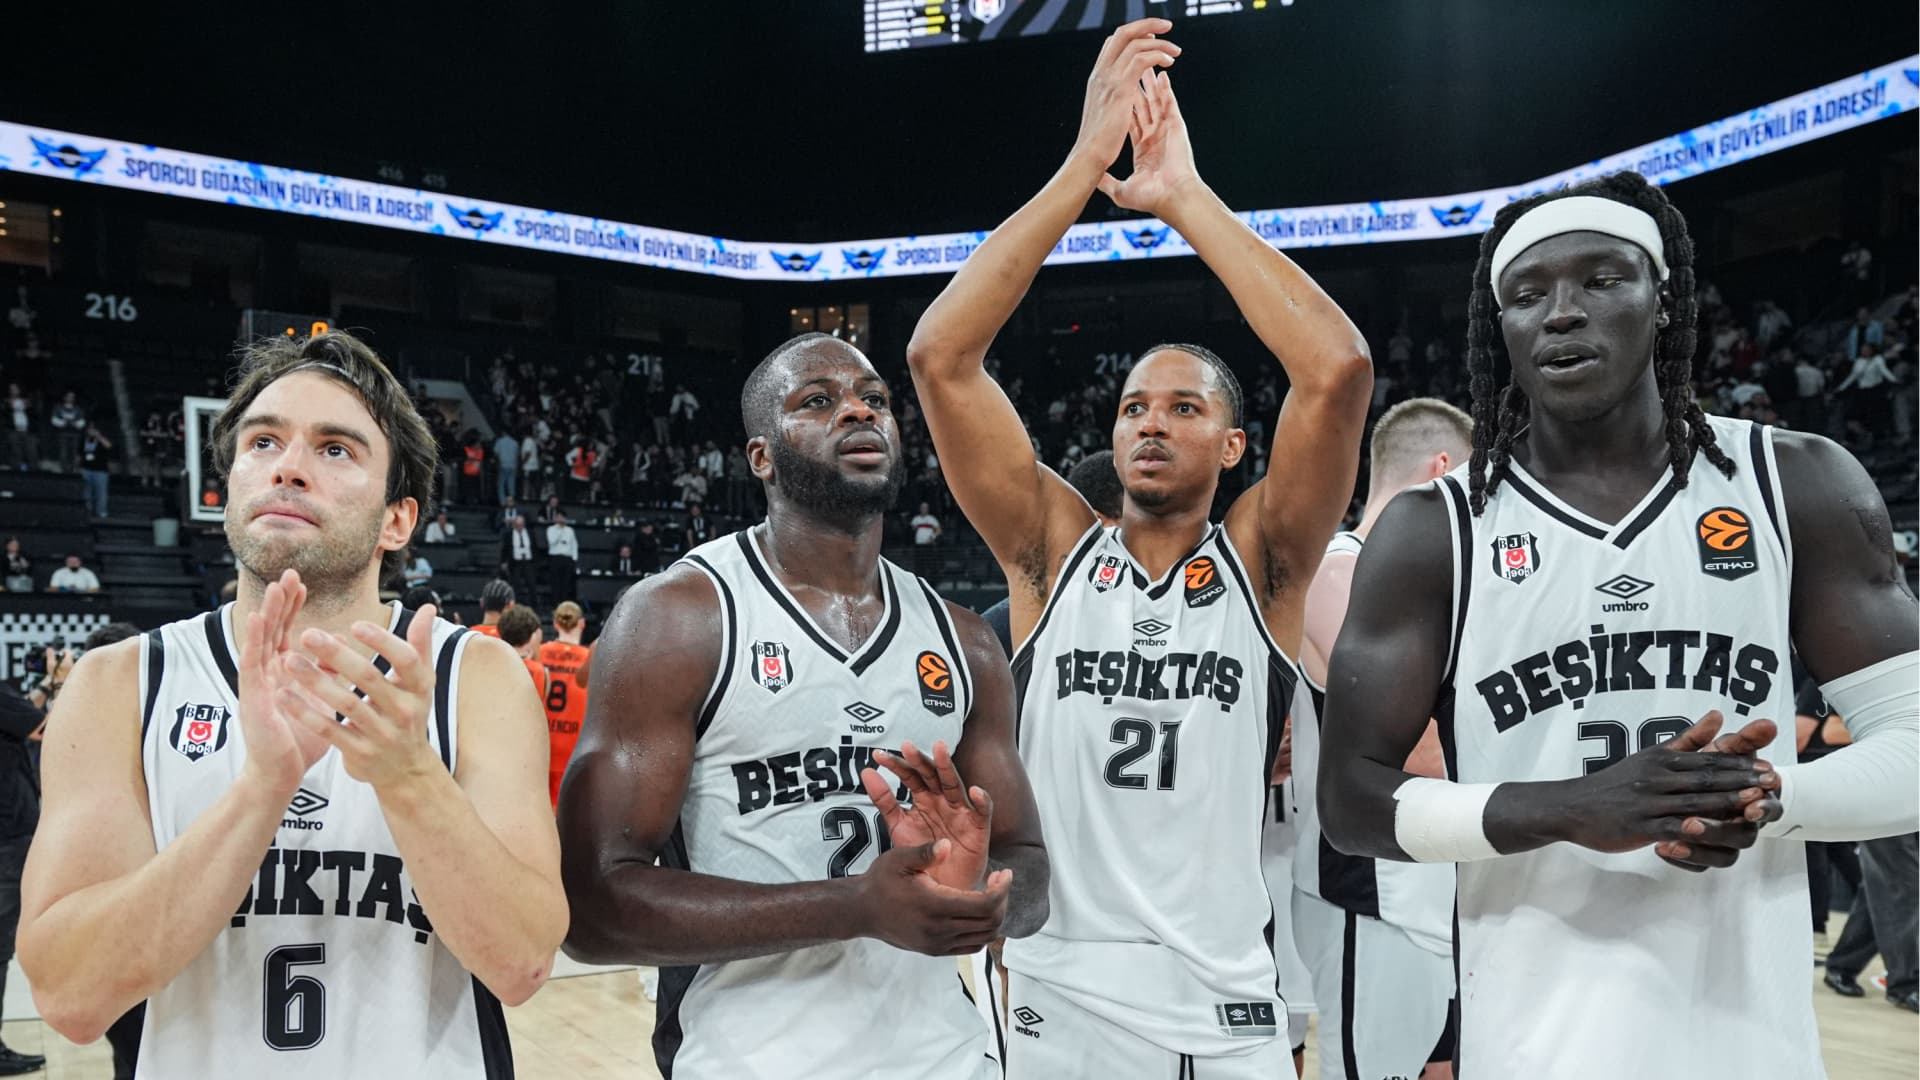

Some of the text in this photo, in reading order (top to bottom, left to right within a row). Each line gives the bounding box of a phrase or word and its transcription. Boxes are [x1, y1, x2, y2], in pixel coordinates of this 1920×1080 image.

[1720, 108, 1807, 155] GÜVENİLİR
[1812, 80, 1886, 127] ADRESİ!
[125, 157, 434, 222] SPORCU GIDASININ GÜVENİLİR ADRESİ!
[515, 219, 570, 244] SPORCU
[574, 228, 640, 254] GIDASININ
[84, 292, 138, 322] 216
[1095, 352, 1133, 375] 214
[1500, 536, 1529, 549] BJK
[1704, 561, 1755, 571] ETIHAD
[1190, 586, 1224, 606] ETIHAD
[1602, 601, 1649, 613] umbro
[757, 644, 784, 656] BJK
[1055, 644, 1244, 714] BEŞİKTAŞ
[1475, 623, 1779, 734] BEŞİKTAŞ
[547, 680, 567, 712] 8
[924, 699, 953, 709] ETIHAD
[185, 706, 223, 721] BJK
[850, 723, 885, 734] umbro
[1103, 716, 1183, 791] 21
[280, 817, 323, 831] mbro
[263, 943, 326, 1052] 6
[1014, 1024, 1040, 1039] umbro
